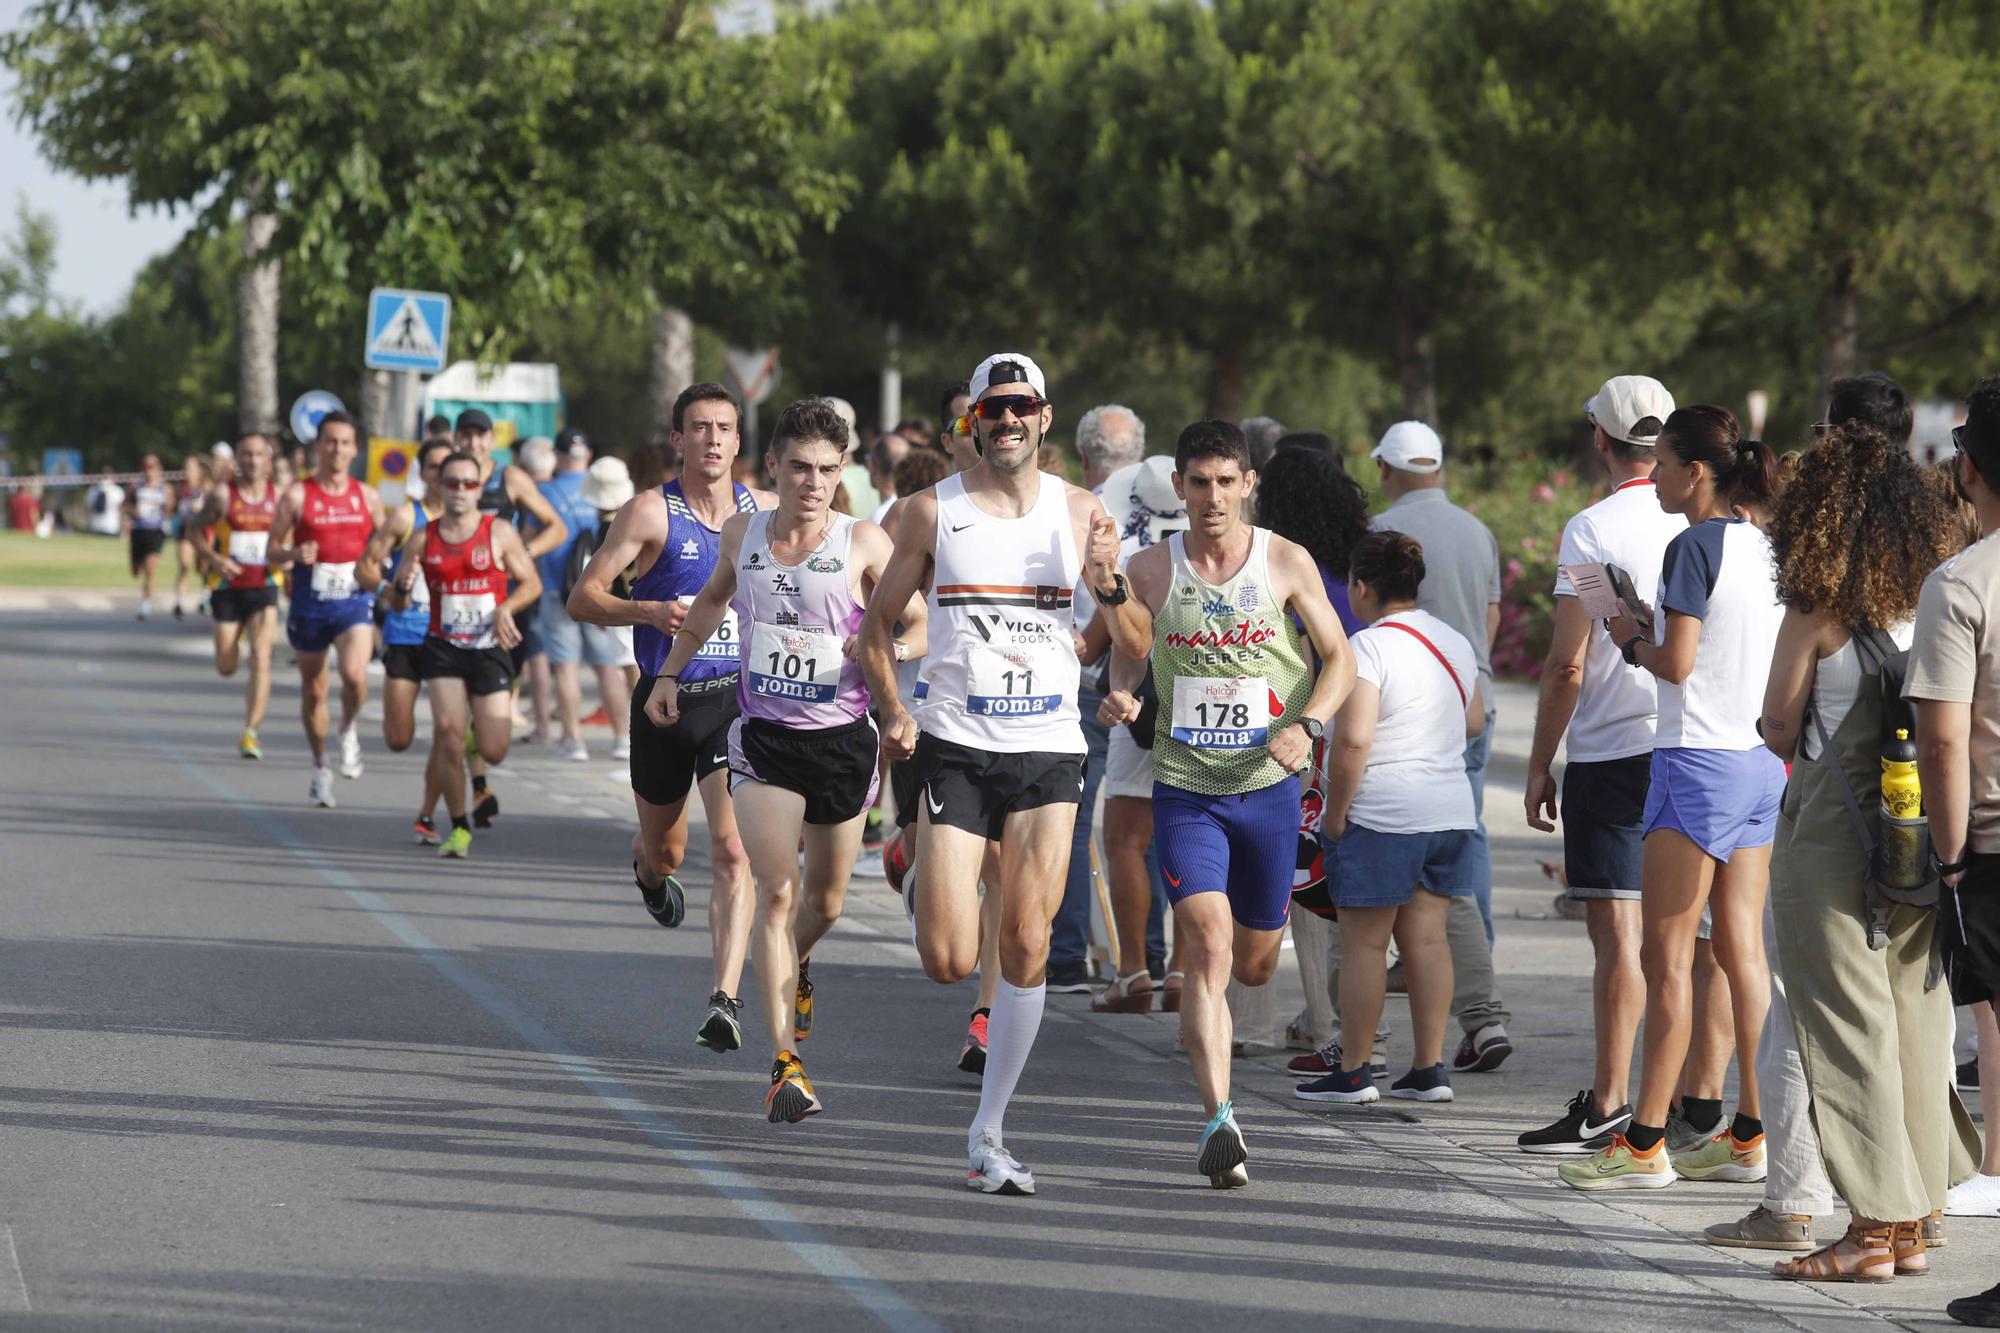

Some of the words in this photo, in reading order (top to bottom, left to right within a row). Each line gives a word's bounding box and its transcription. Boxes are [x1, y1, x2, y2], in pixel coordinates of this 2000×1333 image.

[452, 608, 482, 625] 231
[1005, 621, 1053, 633] VICKY
[717, 619, 731, 641] 6
[1011, 634, 1052, 644] FOODS
[1165, 619, 1276, 648] maratón
[697, 643, 739, 656] oma
[1190, 647, 1264, 666] JEREZ
[768, 651, 817, 682] 101
[676, 681, 705, 693] KE
[705, 672, 739, 692] PRO
[1001, 670, 1032, 695] 11
[1194, 702, 1249, 729] 178
